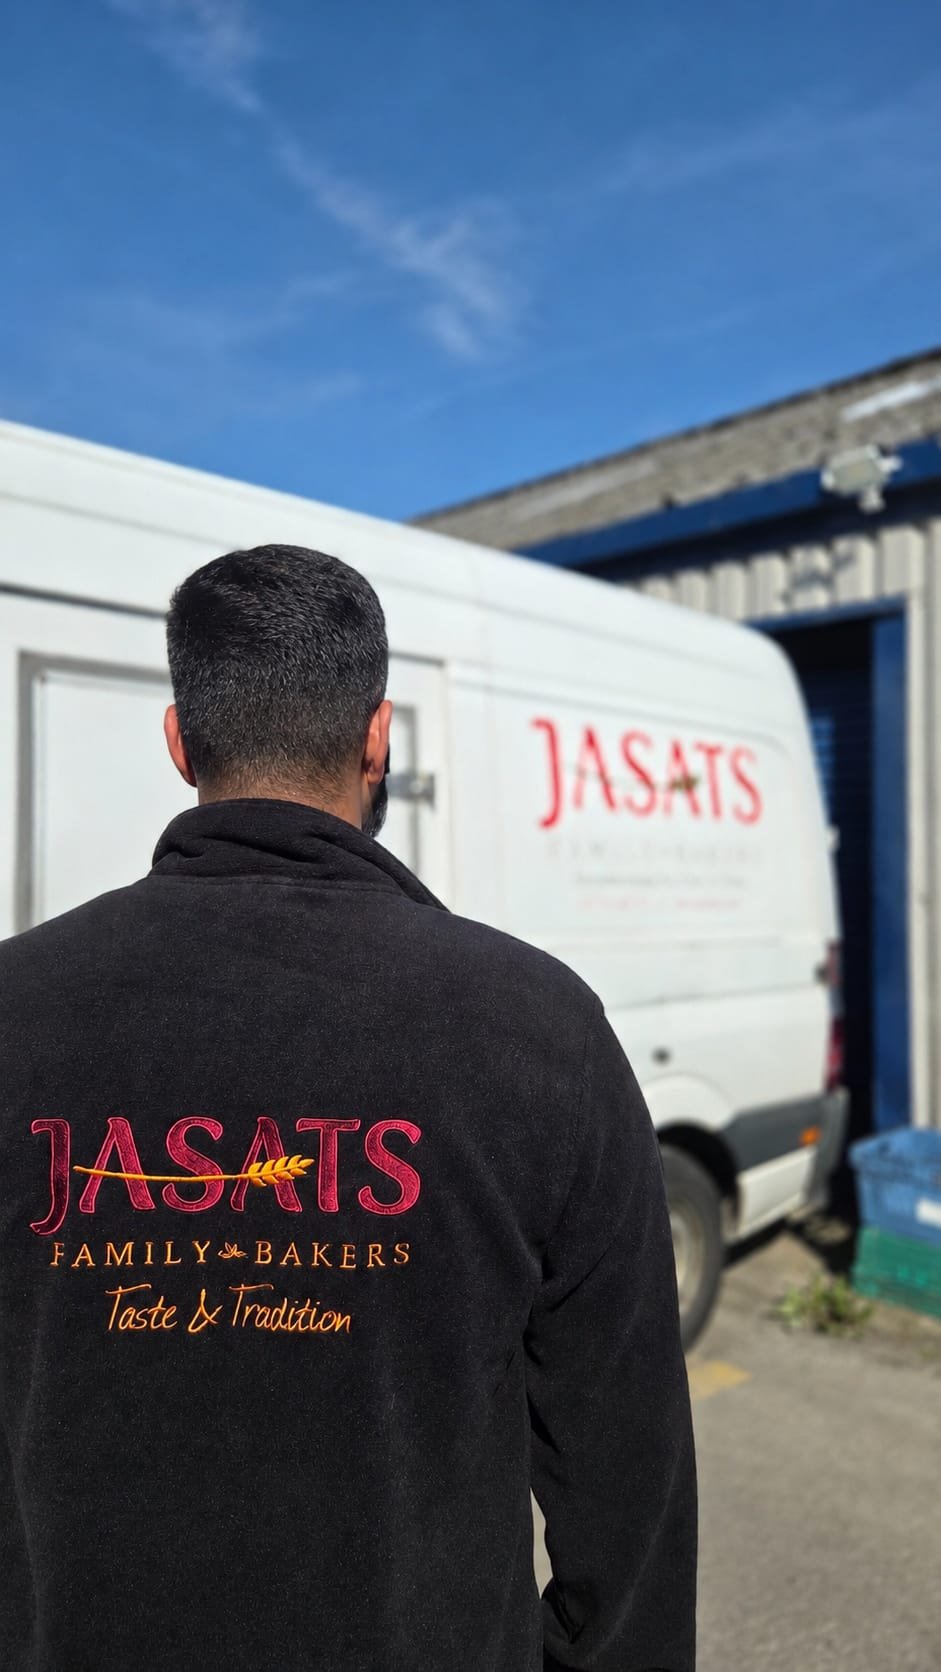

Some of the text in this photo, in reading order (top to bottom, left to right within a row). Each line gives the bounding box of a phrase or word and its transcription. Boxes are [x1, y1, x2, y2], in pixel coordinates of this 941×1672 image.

[531, 717, 763, 829] JASATS
[29, 1116, 422, 1235] JASATS
[50, 1241, 411, 1268] FAMILY BAKERS
[105, 1283, 352, 1333] Taste & Tradition
